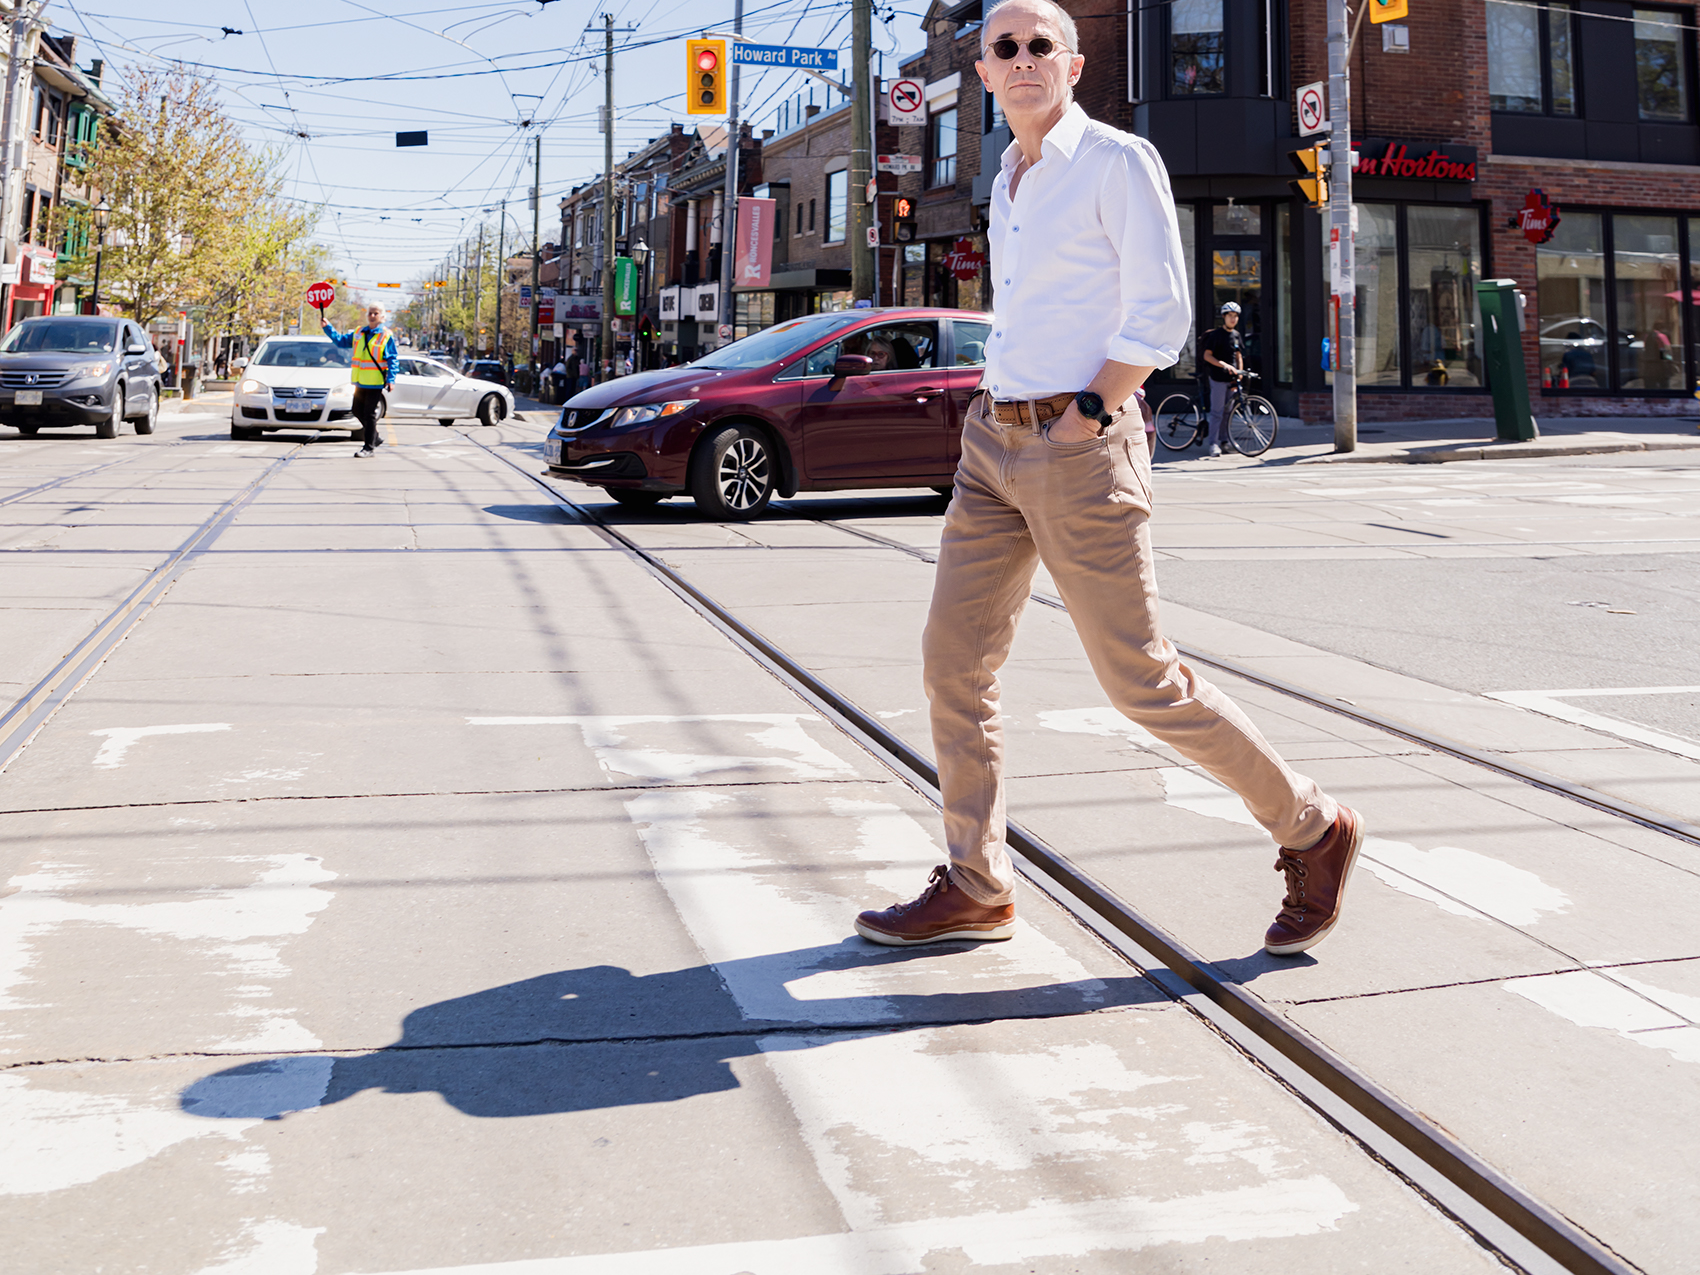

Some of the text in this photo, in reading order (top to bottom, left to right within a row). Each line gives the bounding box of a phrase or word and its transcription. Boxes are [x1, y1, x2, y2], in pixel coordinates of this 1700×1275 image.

[734, 45, 837, 66] Howard Park Av
[1380, 142, 1476, 180] Hortons
[1520, 208, 1547, 230] Tims
[749, 206, 761, 263] RONCESVALLES
[949, 252, 982, 270] Tims
[308, 288, 333, 302] STOP
